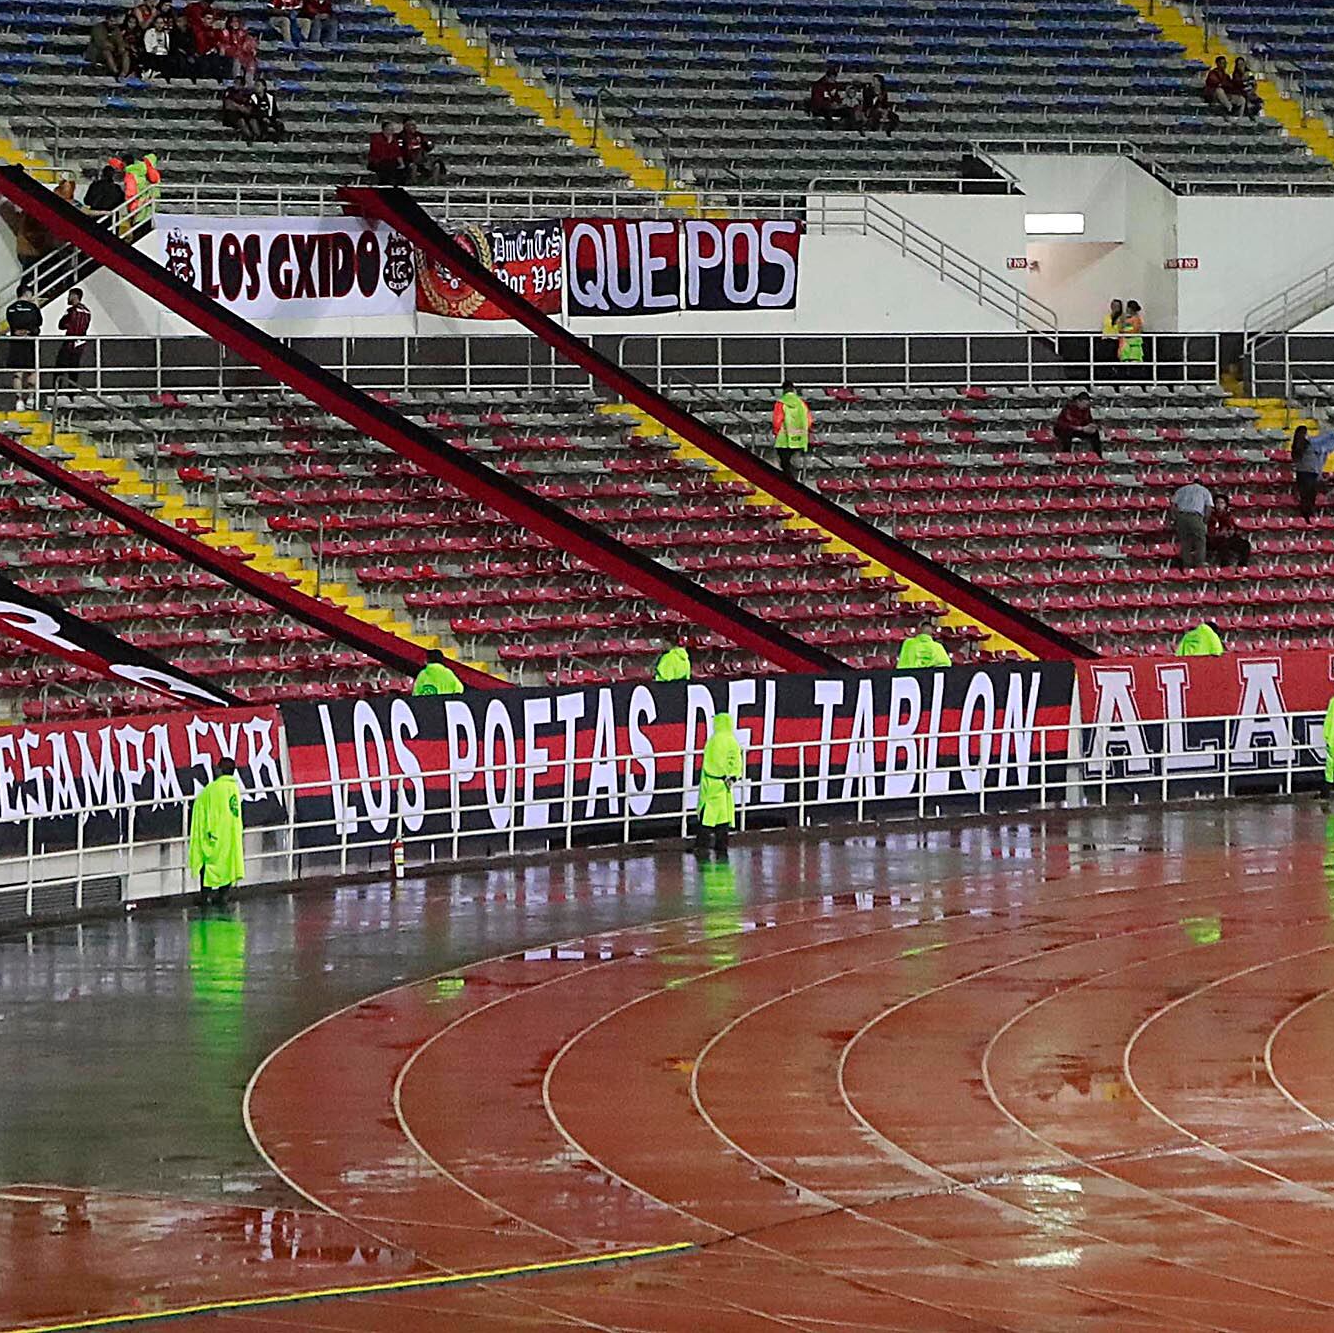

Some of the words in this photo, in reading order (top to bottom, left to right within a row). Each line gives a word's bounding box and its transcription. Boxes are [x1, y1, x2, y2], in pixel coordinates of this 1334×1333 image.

[198, 232, 261, 301] LOS
[268, 230, 380, 300] GXIDO
[568, 221, 796, 309] QUEPOS
[318, 698, 425, 836] LOS
[446, 687, 657, 830] POETAS
[683, 679, 785, 810] DEL
[815, 671, 1042, 804] TABLON
